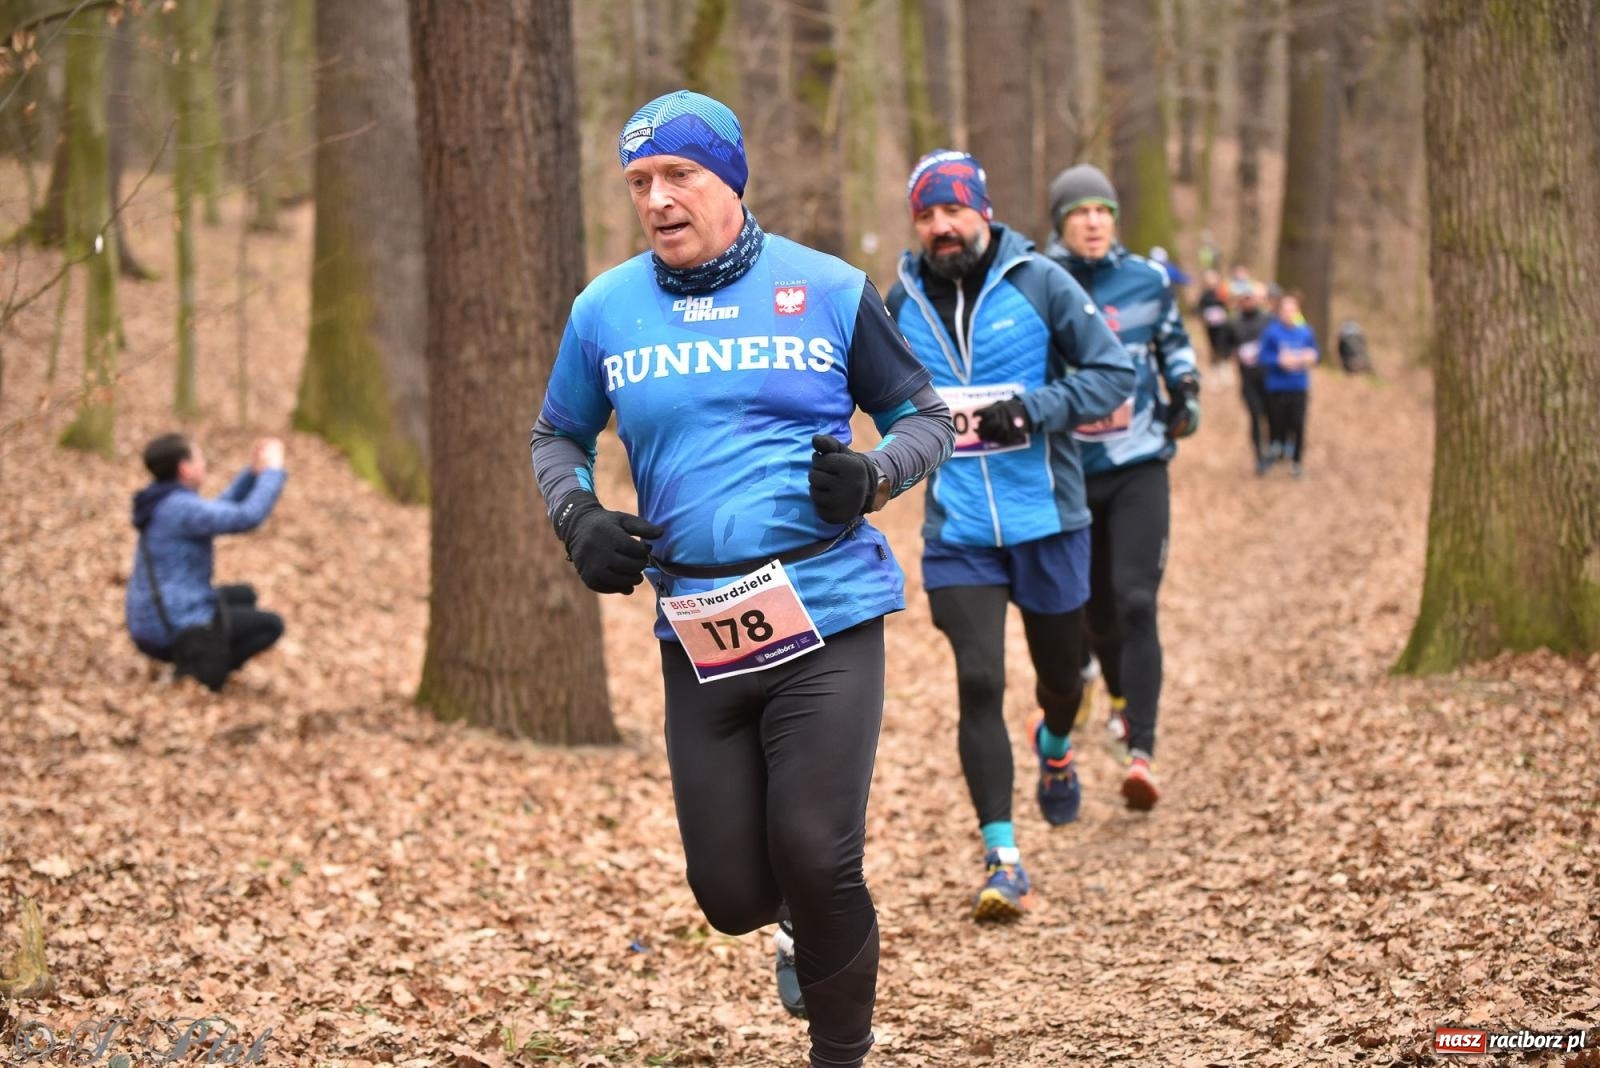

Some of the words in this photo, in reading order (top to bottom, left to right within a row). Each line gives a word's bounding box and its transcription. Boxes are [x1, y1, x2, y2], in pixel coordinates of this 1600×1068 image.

[683, 306, 740, 322] okna
[603, 336, 834, 392] RUNNERS
[670, 599, 696, 610] BIEG
[696, 572, 772, 607] Twardziela
[701, 609, 774, 650] 178
[764, 643, 796, 660] Racibórz
